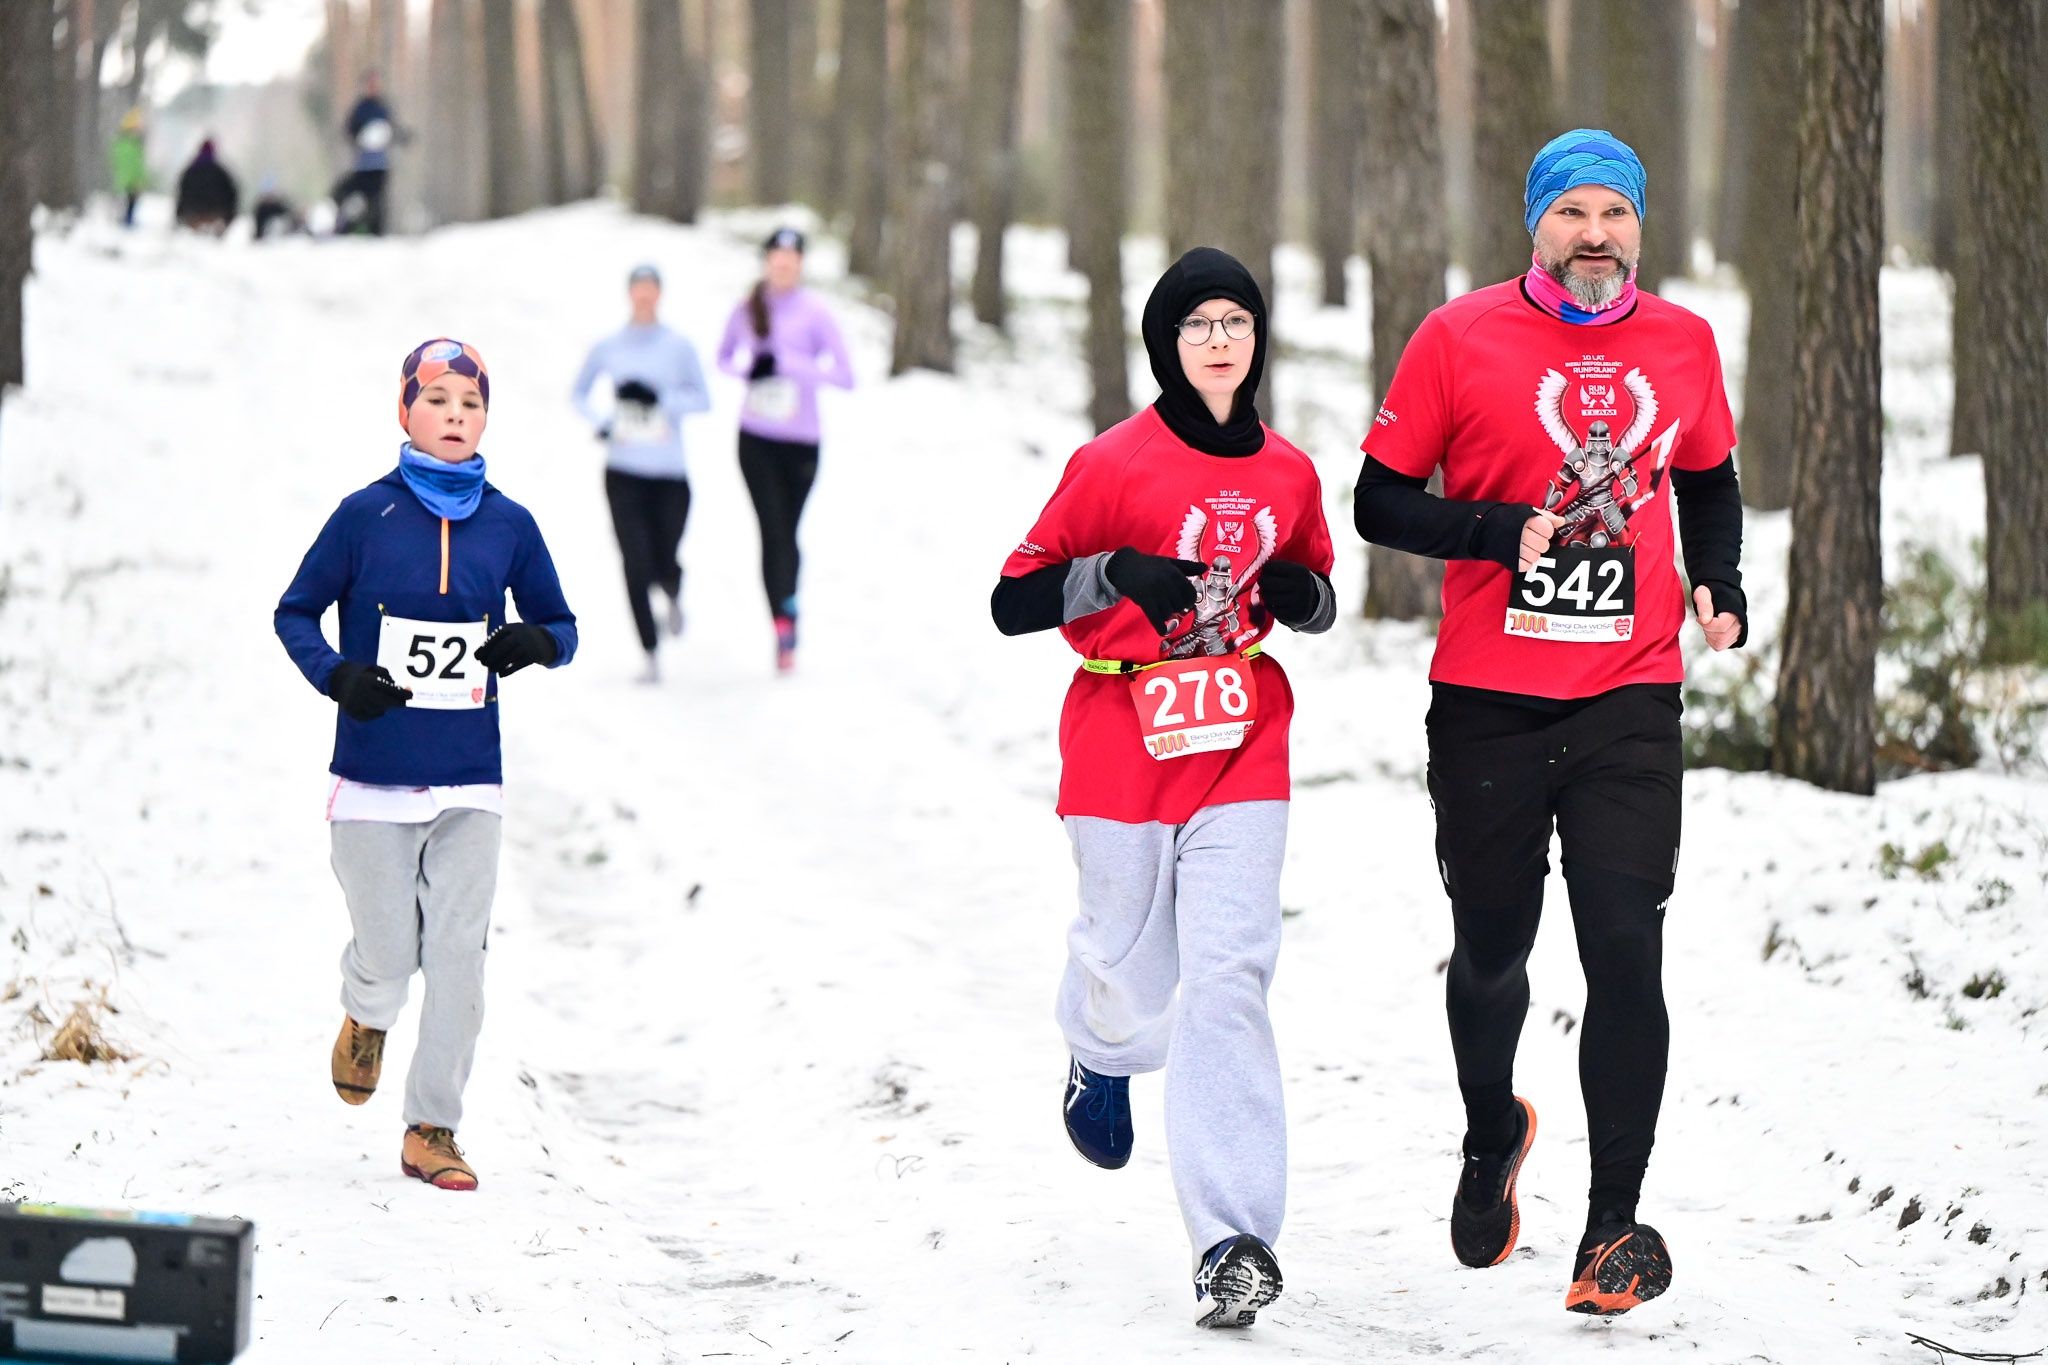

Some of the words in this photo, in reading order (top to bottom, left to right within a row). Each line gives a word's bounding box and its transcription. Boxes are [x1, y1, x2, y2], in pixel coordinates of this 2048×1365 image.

[1588, 384, 1606, 392] RUN
[1521, 557, 1624, 611] 542
[406, 634, 467, 679] 52
[1144, 667, 1249, 728] 278
